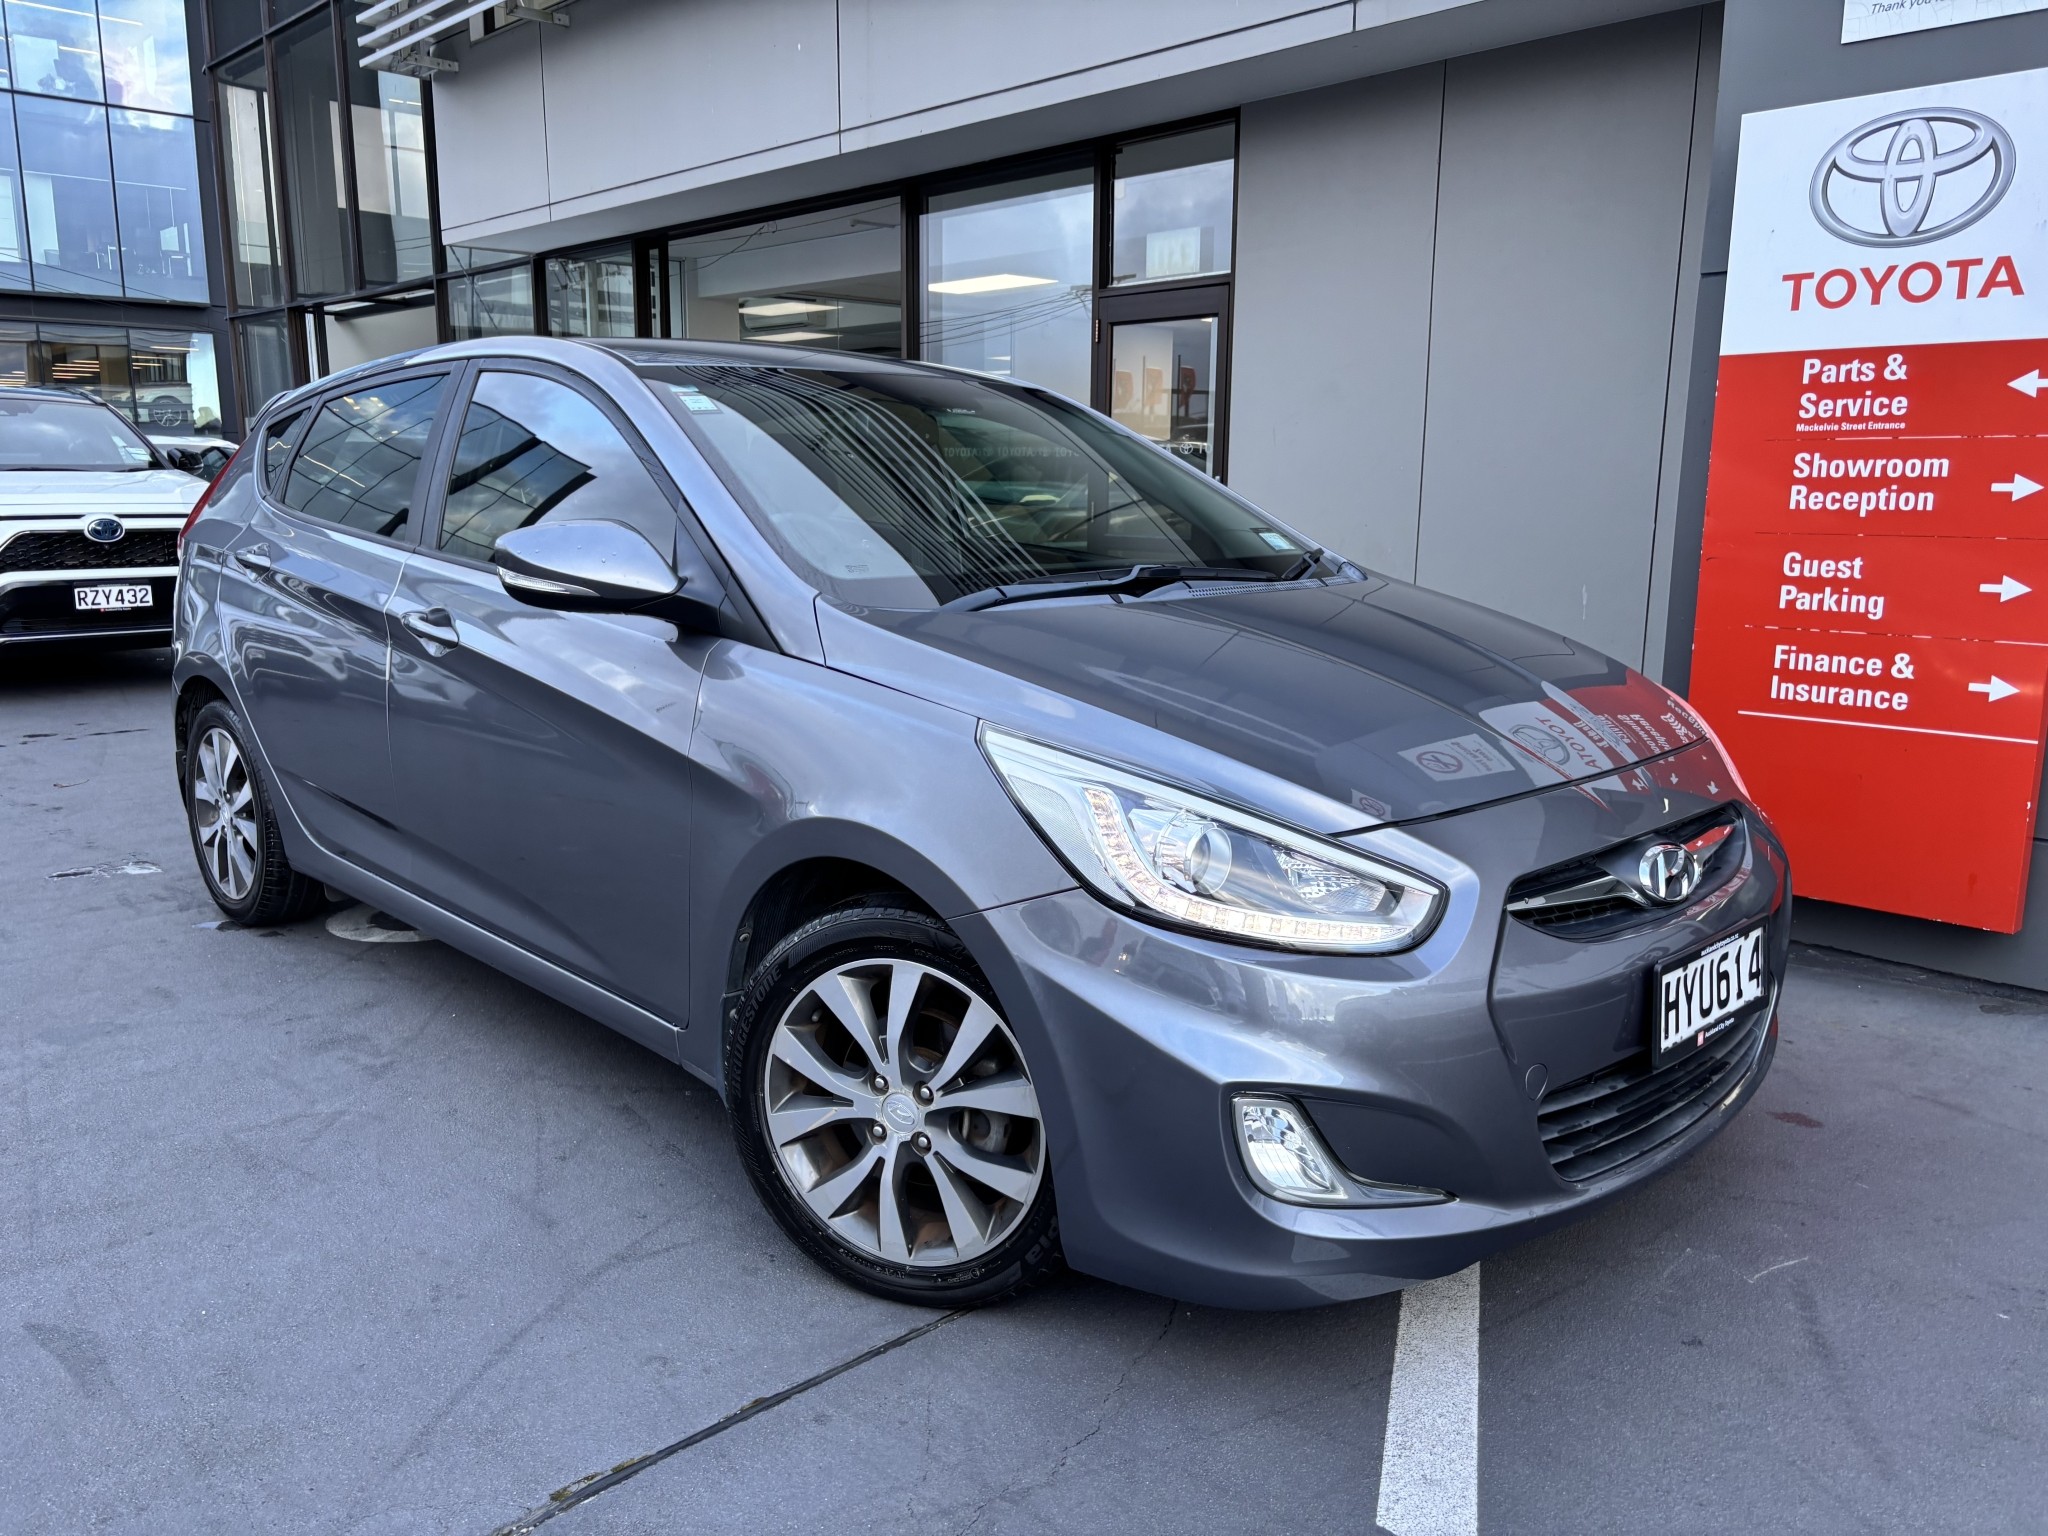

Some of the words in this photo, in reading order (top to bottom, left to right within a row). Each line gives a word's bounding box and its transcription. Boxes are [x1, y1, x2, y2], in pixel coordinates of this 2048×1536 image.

[1871, 0, 1907, 15] Thank
[1781, 255, 2025, 312] TOYOTA
[1802, 358, 1876, 385] Parts
[1883, 353, 1908, 381] &
[1798, 390, 1908, 419] Service
[1796, 423, 1839, 432] Mackelvie
[1841, 422, 1866, 431] Street
[1868, 421, 1906, 430] Entrance
[1792, 452, 1950, 478] Showroom
[1789, 484, 1935, 517] Reception
[1782, 552, 1863, 579] Guest
[77, 587, 150, 607] RZY432
[1779, 584, 1885, 620] Parking
[1773, 644, 1883, 677] Finance
[1890, 653, 1915, 680] &
[1770, 675, 1909, 711] Insurance
[1664, 934, 1761, 1041] HYU614
